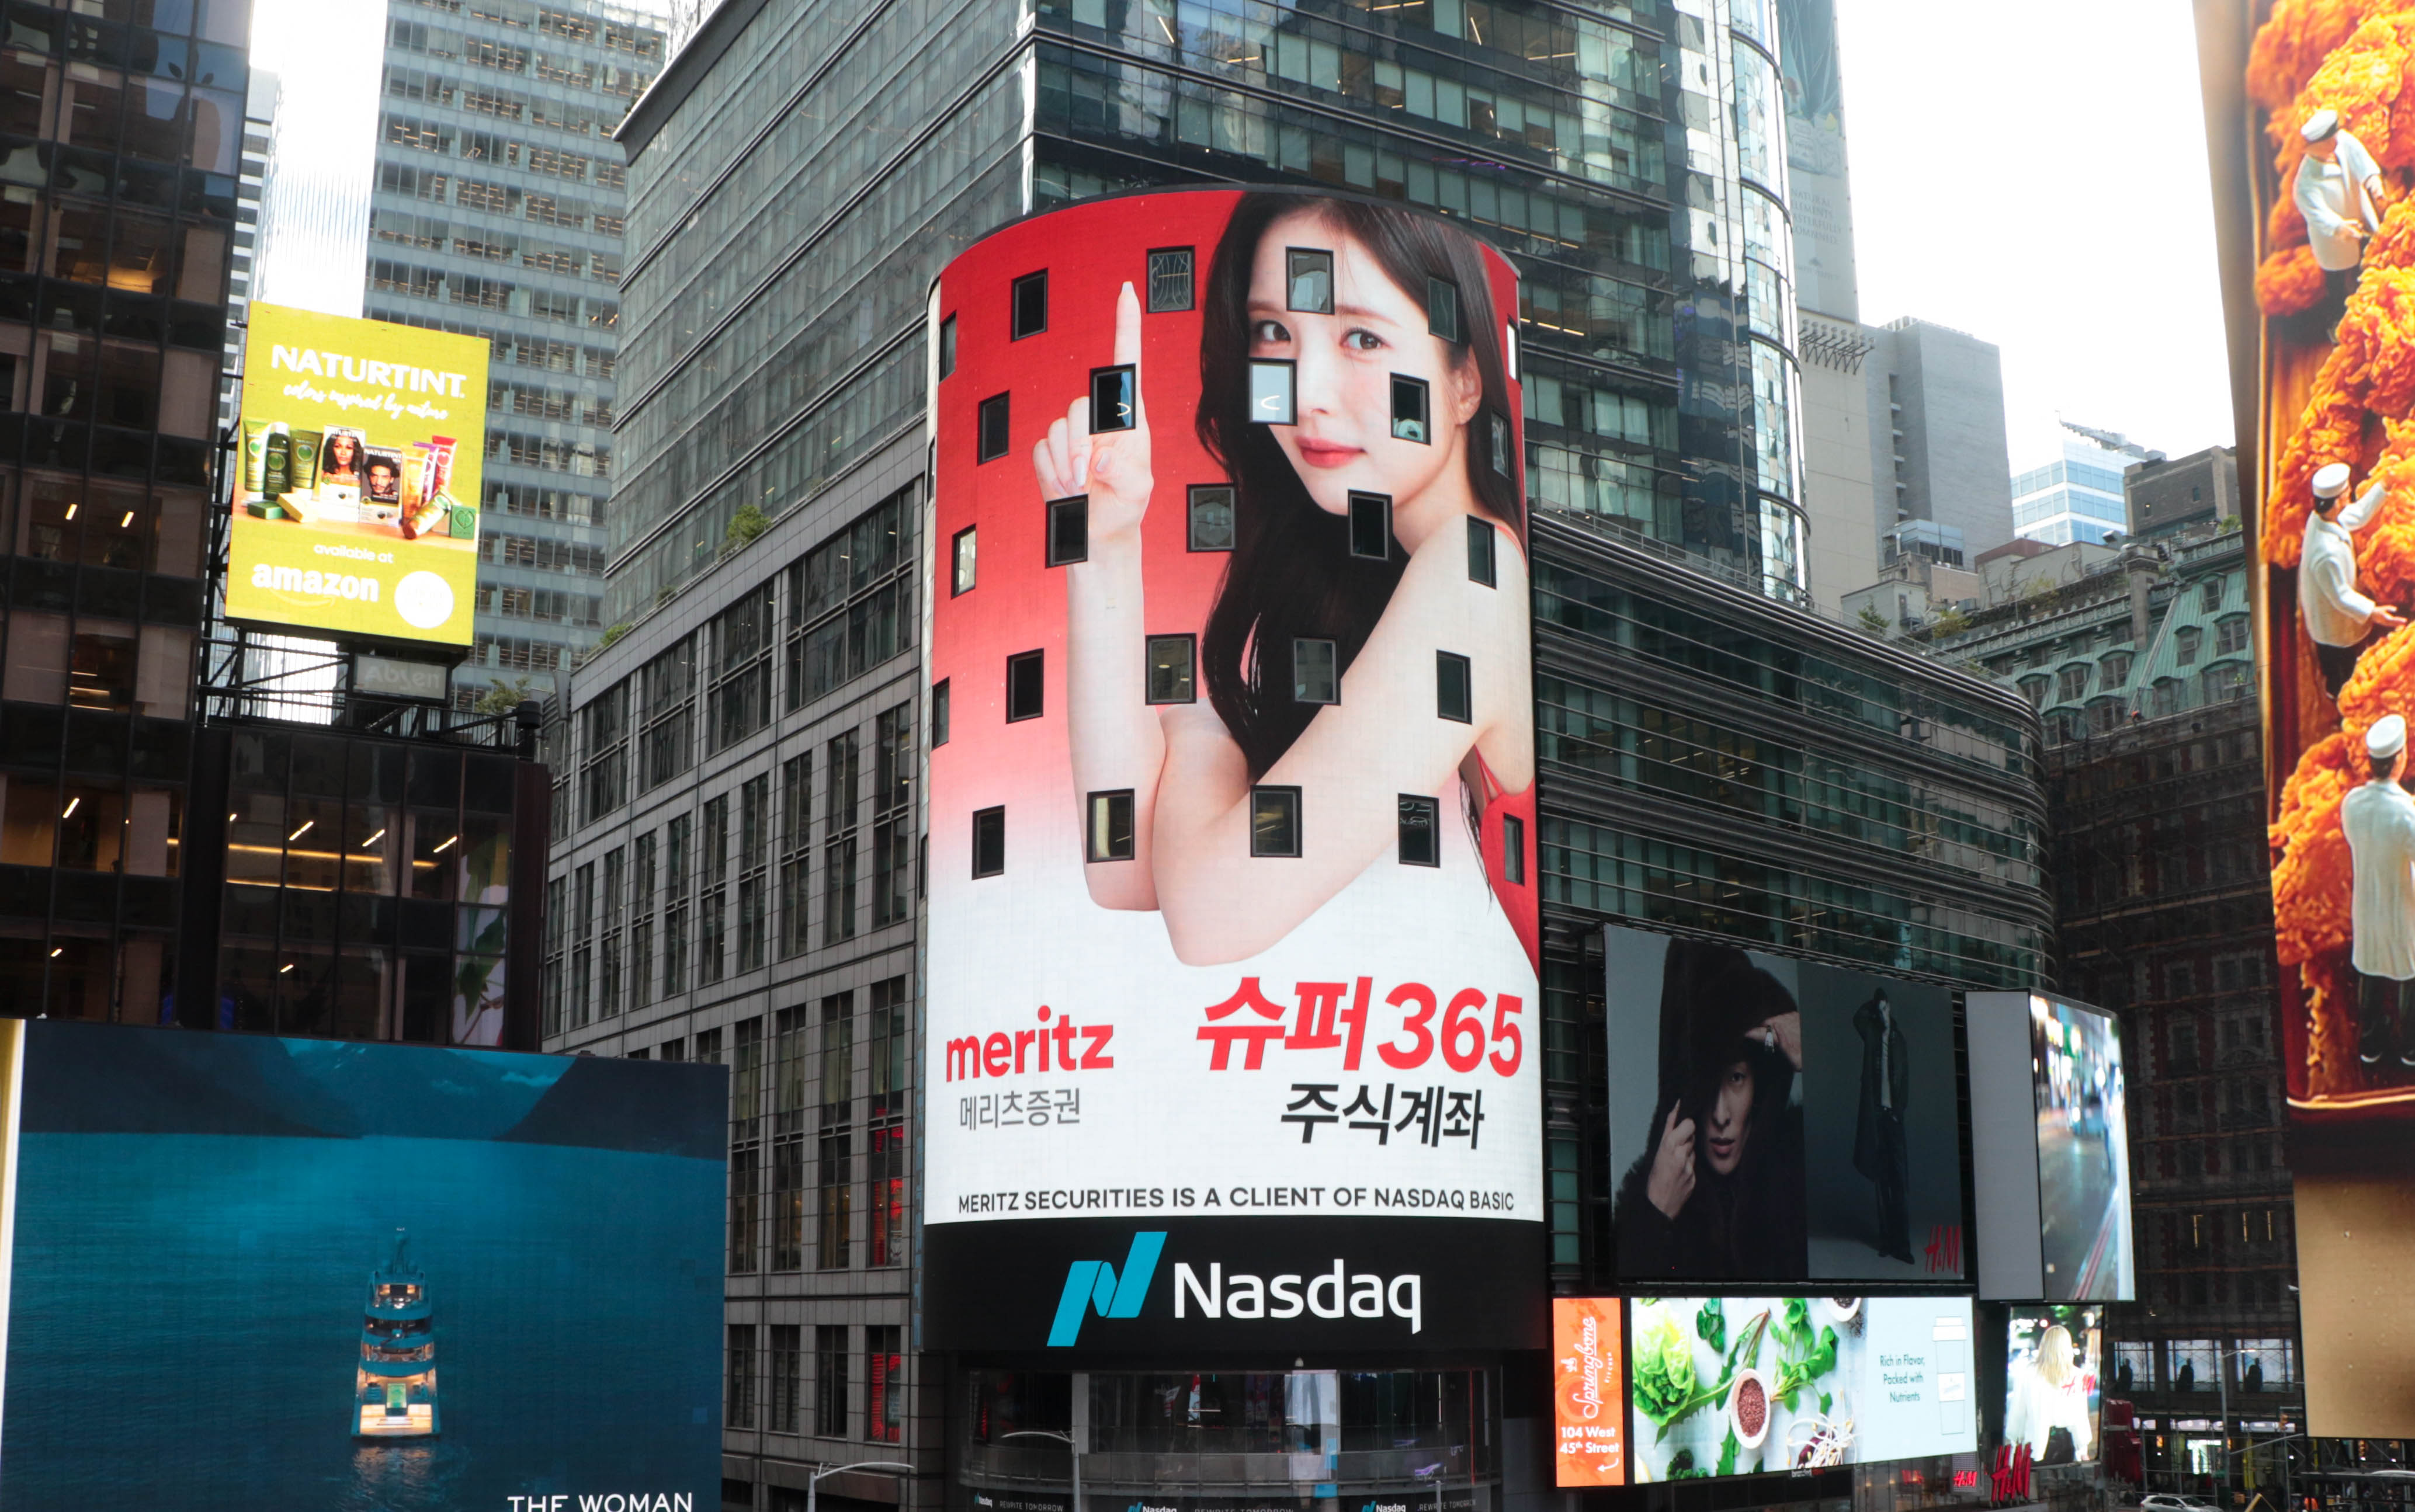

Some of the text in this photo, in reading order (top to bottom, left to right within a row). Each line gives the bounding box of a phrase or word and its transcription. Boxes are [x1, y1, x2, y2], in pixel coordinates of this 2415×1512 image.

[384, 393, 404, 419] by
[313, 544, 394, 564] available at
[251, 564, 380, 602] amazon
[1196, 976, 1522, 1077] 슈퍼 365
[946, 1005, 1113, 1082] meritz
[960, 1087, 1080, 1131] 메리츠증권
[1281, 1083, 1485, 1150] 주식계좌
[959, 1187, 1514, 1213] MERITZ SECURITIES IS A CLIENT OF NASDAQ BASIC
[1925, 1225, 1961, 1274] H&M
[1174, 1259, 1422, 1334] Nasdaq
[1572, 1316, 1604, 1419] Springbone
[1880, 1353, 1925, 1367] Rich in Flavor,
[1883, 1372, 1924, 1385] Packed with
[1889, 1391, 1920, 1403] Nutrients
[1561, 1426, 1616, 1438] 104 West
[1559, 1441, 1620, 1455] 45th Street
[1953, 1470, 1978, 1487] H&M
[1991, 1444, 2032, 1501] H&M
[506, 1492, 692, 1512] THE WOMAN
[1025, 1503, 1064, 1512] TOMORROW
[1376, 1503, 1407, 1512] Nasdaq
[1419, 1501, 1446, 1511] REWRTE
